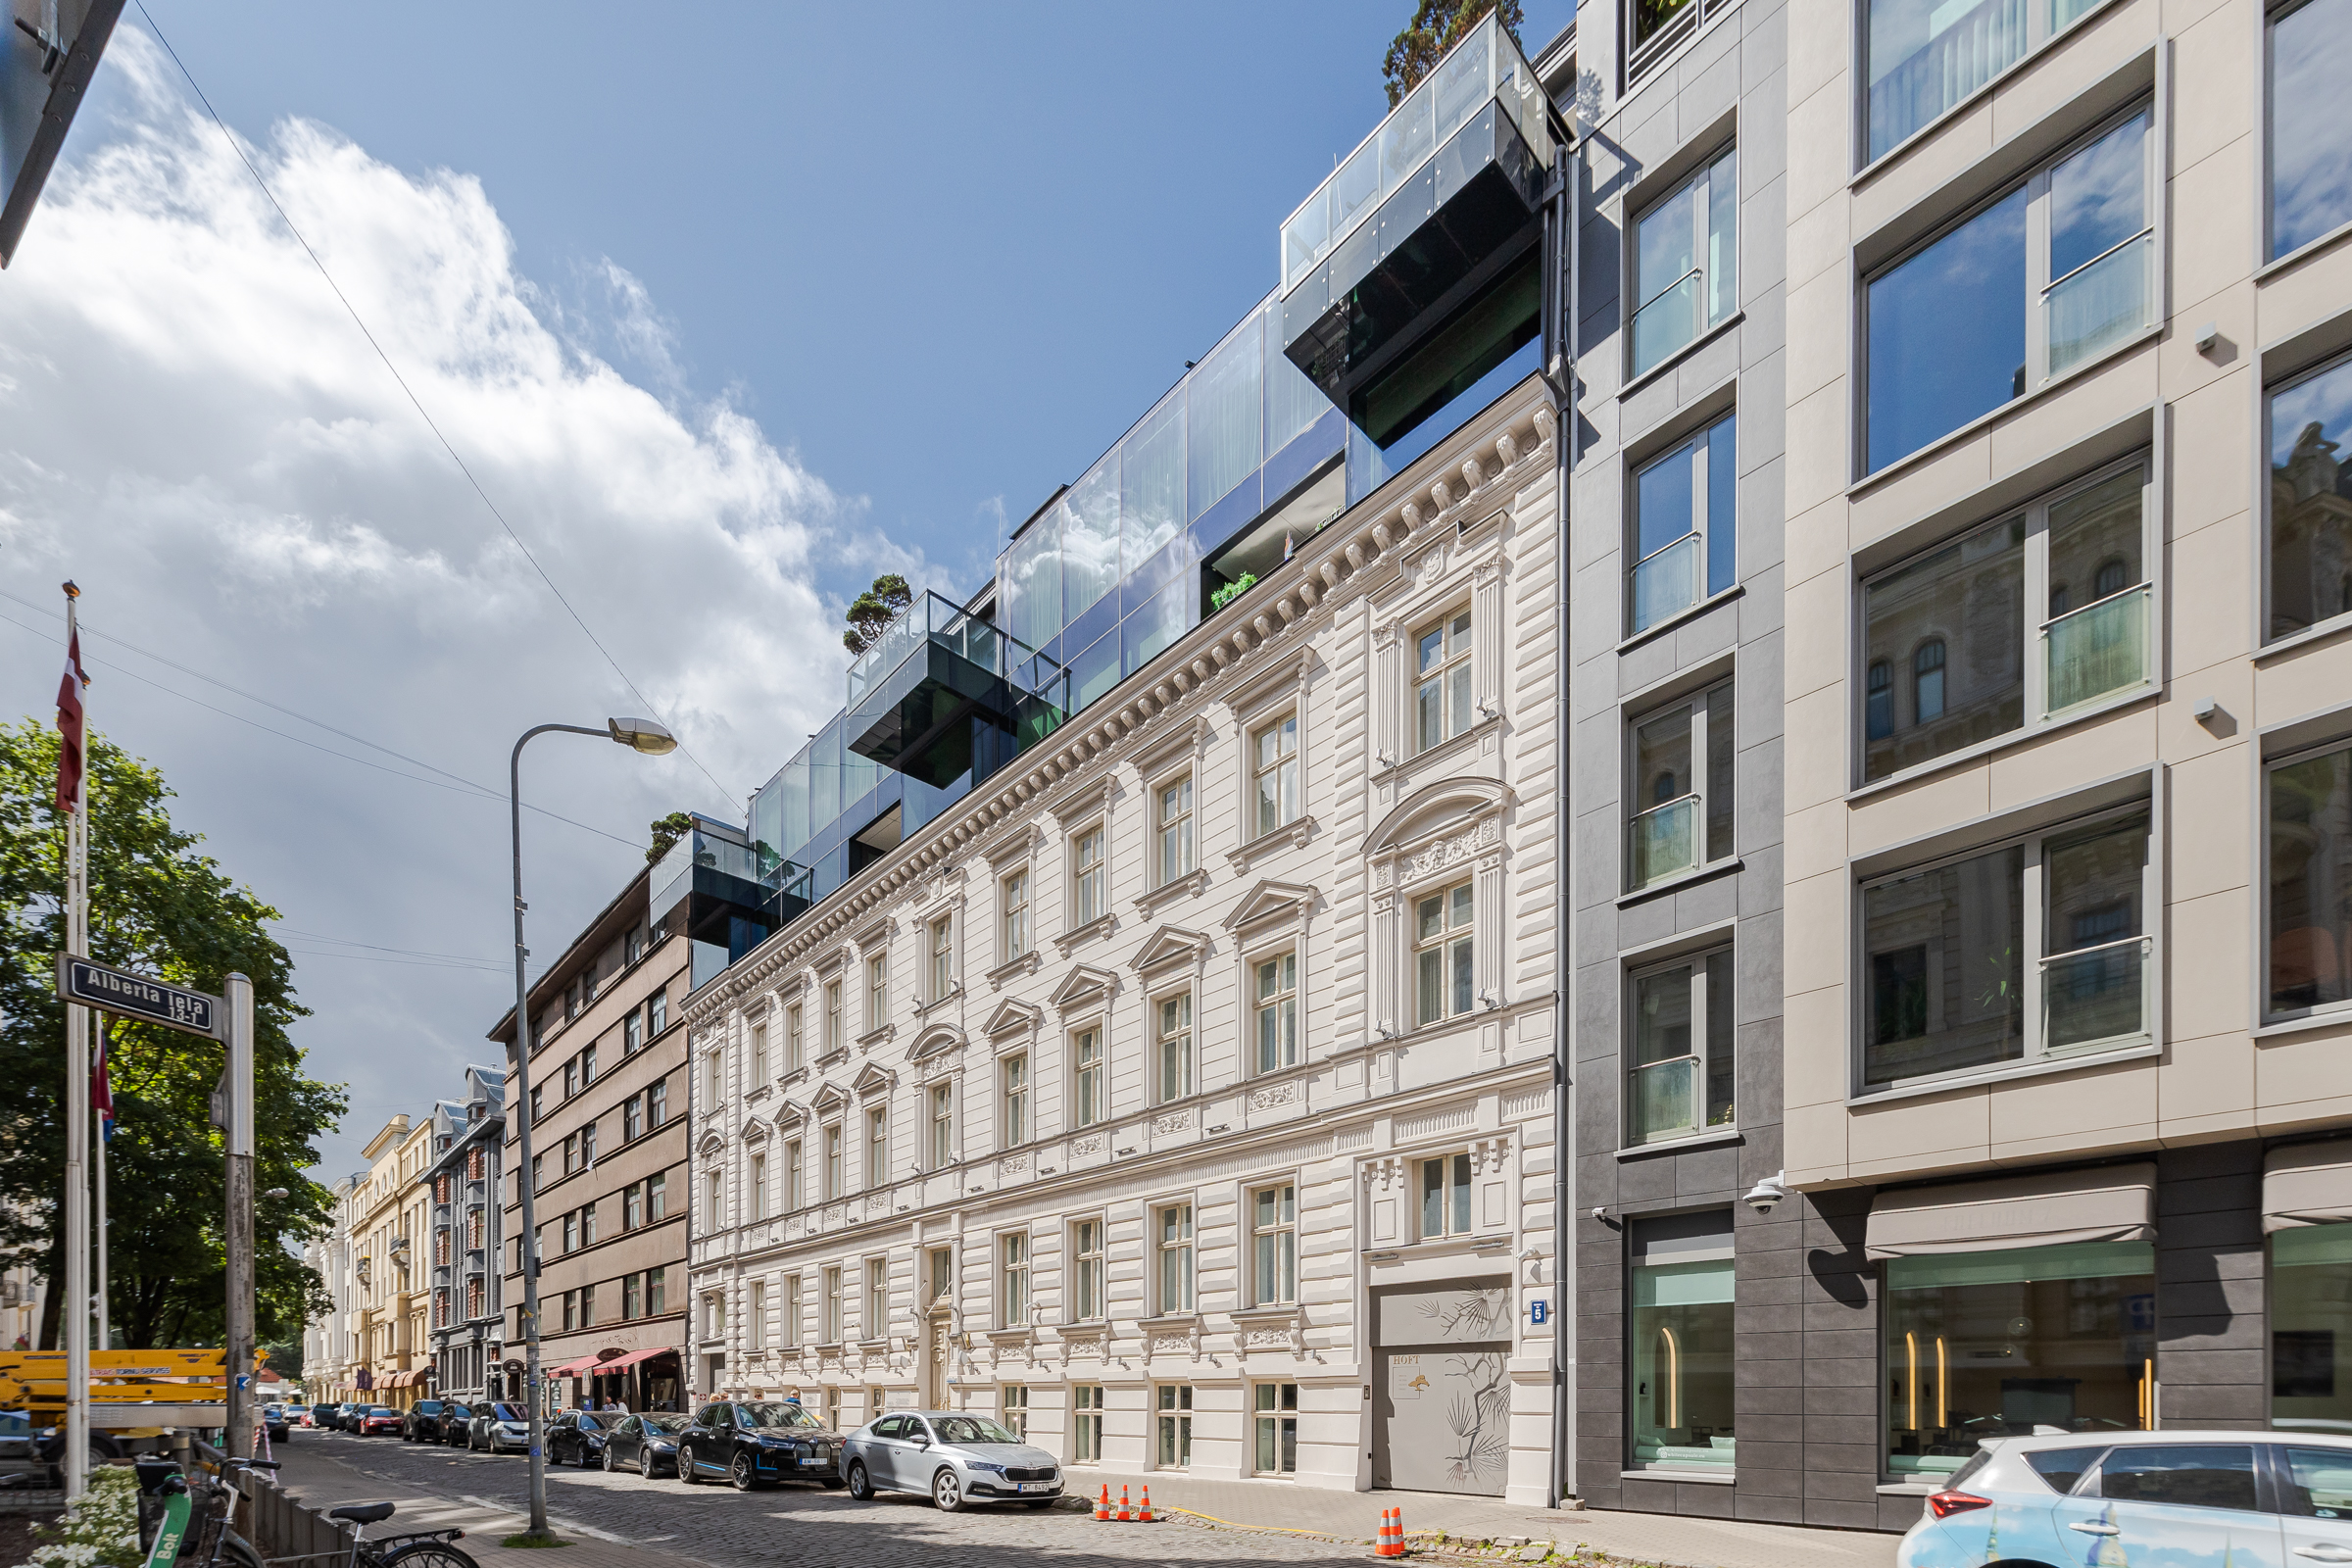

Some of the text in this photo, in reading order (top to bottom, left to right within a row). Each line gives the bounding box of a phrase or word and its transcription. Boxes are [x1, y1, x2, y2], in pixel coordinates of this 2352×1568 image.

[87, 969, 203, 1014] Alberta iela
[169, 1006, 197, 1024] 13-1
[1535, 1308, 1542, 1320] 5
[1393, 1355, 1421, 1364] HOFT
[155, 1533, 180, 1559] Bolt
